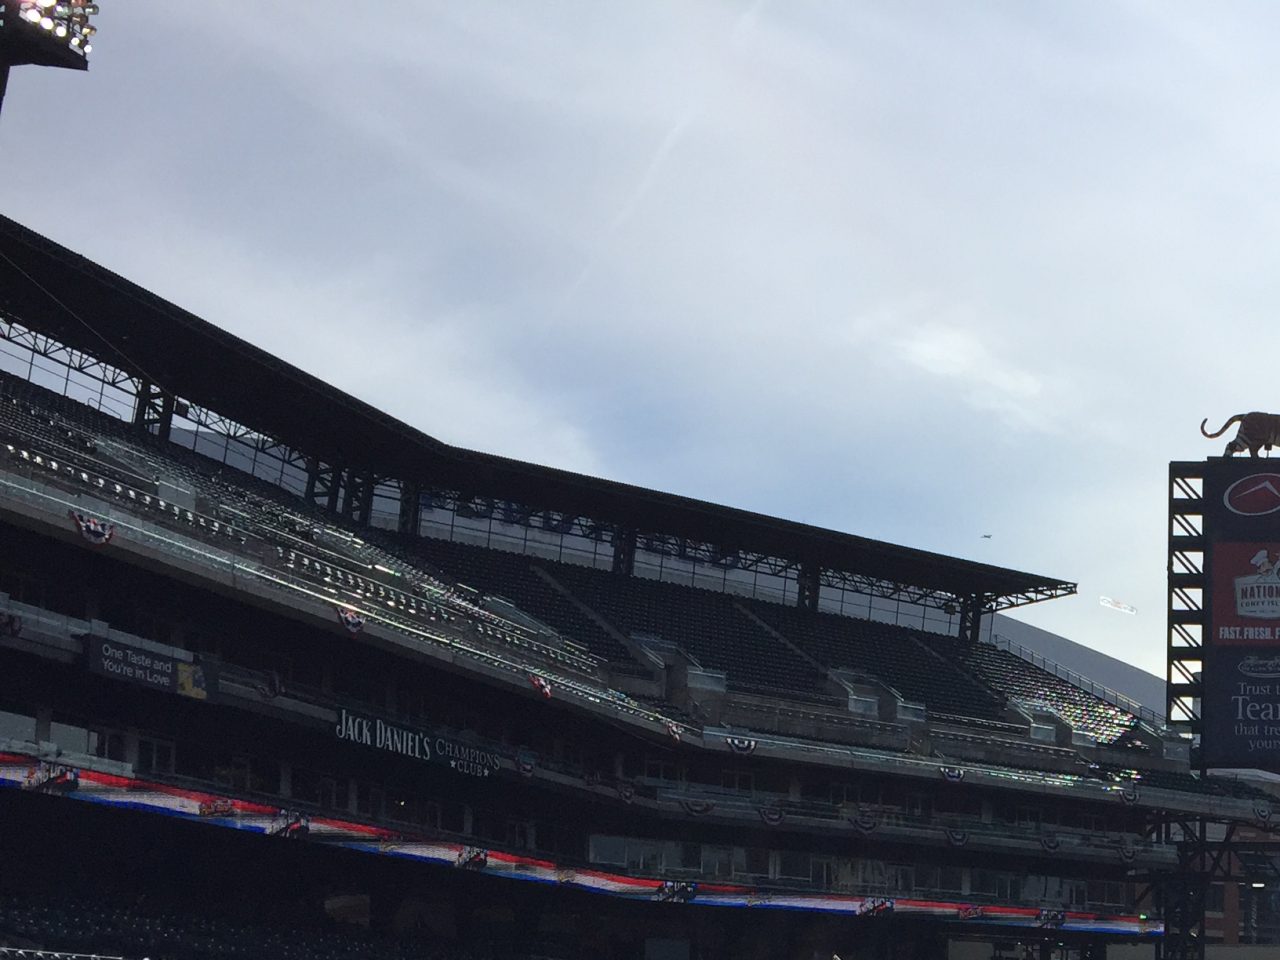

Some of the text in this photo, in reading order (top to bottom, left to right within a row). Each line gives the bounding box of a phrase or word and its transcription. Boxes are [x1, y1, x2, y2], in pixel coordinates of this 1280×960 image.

[1219, 626, 1242, 640] FAST.
[1243, 626, 1273, 640] FRESH.
[102, 643, 172, 673] One Taste and
[102, 657, 170, 687] You're in Love
[1237, 682, 1271, 695] Trust
[1234, 722, 1259, 735] that
[335, 708, 500, 770] JACK DANIEL'S CHAMPIONS
[457, 759, 483, 777] CLUB
